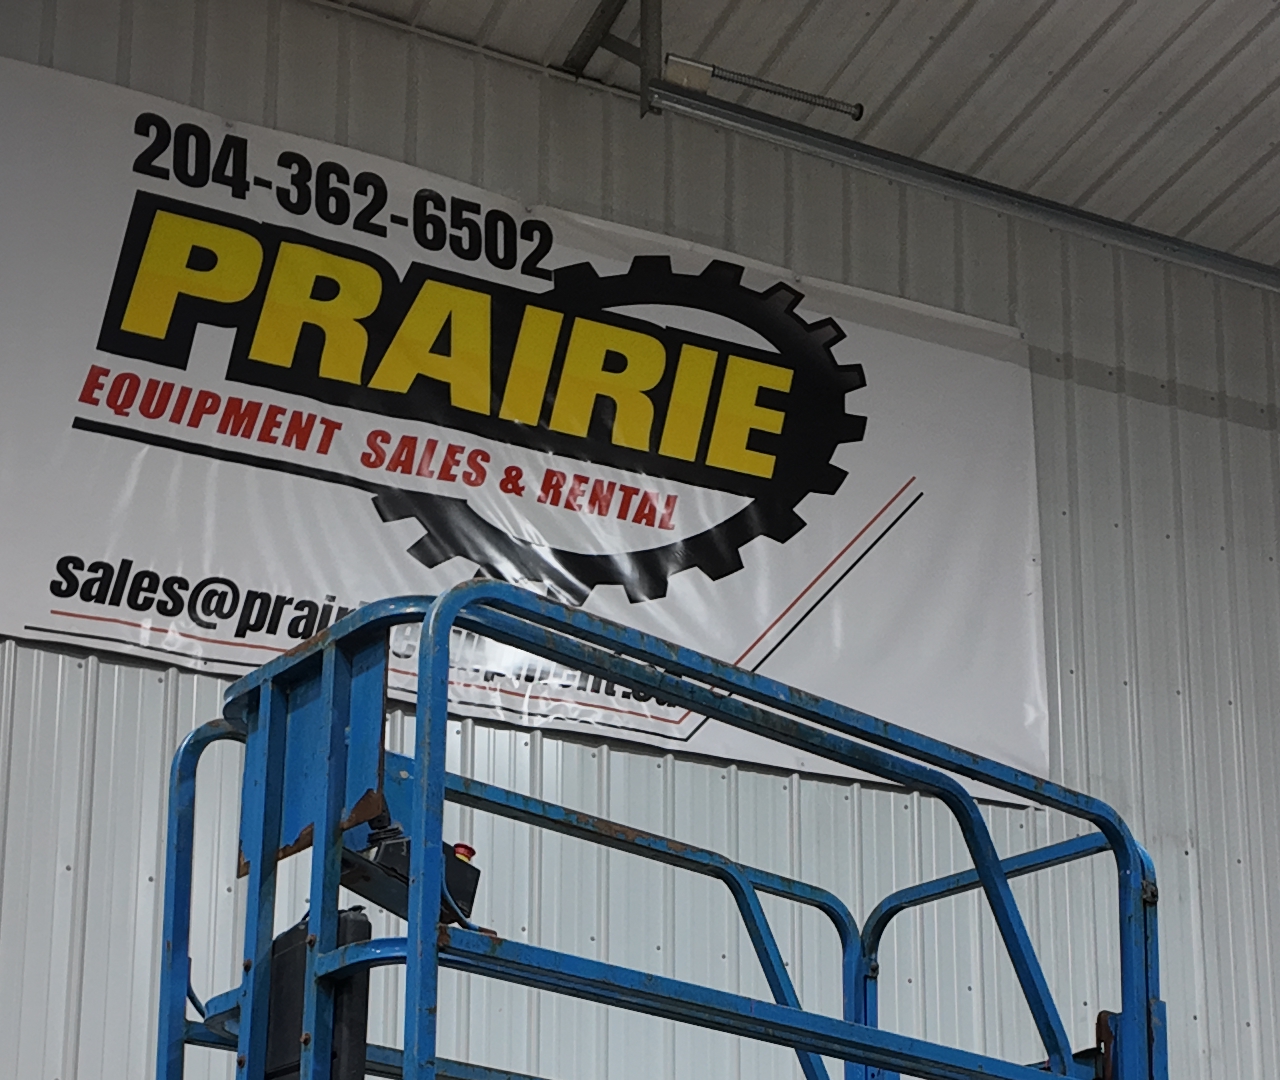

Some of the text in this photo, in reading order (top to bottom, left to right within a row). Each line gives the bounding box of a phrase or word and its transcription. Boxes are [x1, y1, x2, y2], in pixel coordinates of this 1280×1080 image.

[132, 111, 554, 282] 204-362-6502
[119, 209, 794, 480] PRAIRIE
[78, 364, 679, 531] EQUIPMENT SALES & RENTAL
